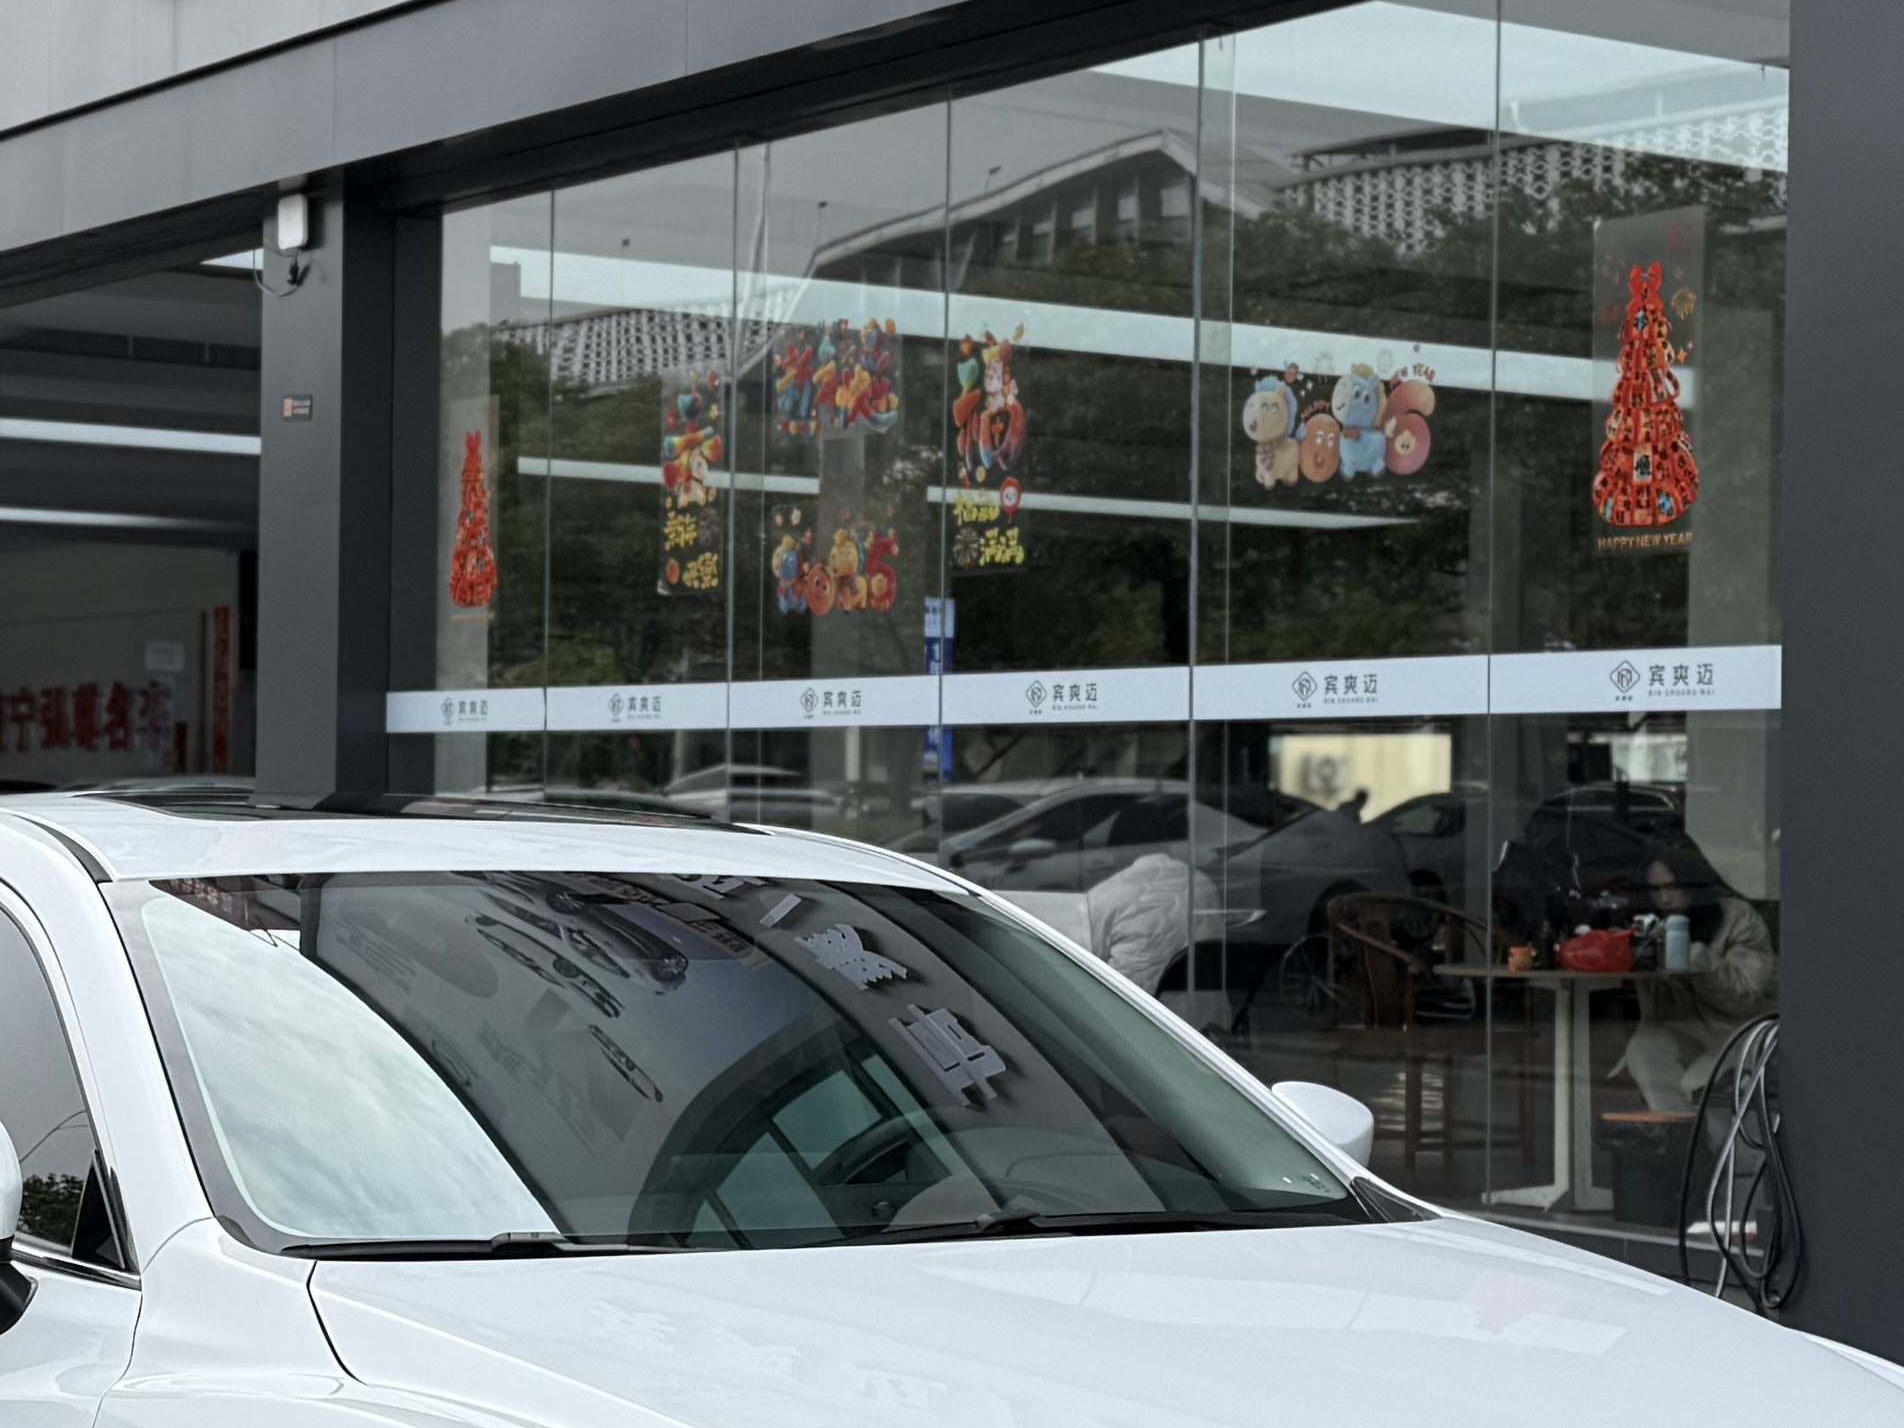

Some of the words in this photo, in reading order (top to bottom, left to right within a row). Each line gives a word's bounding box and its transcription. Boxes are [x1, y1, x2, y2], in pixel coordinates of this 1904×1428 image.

[1598, 535, 1633, 550] HAPPY
[1636, 534, 1662, 547] NEW
[1663, 531, 1694, 546] YEAR
[1324, 673, 1378, 695] 宾爽迈
[1648, 663, 1714, 686] 宾爽迈
[823, 690, 862, 708] 宾爽迈
[1052, 683, 1098, 702] 宾爽迈
